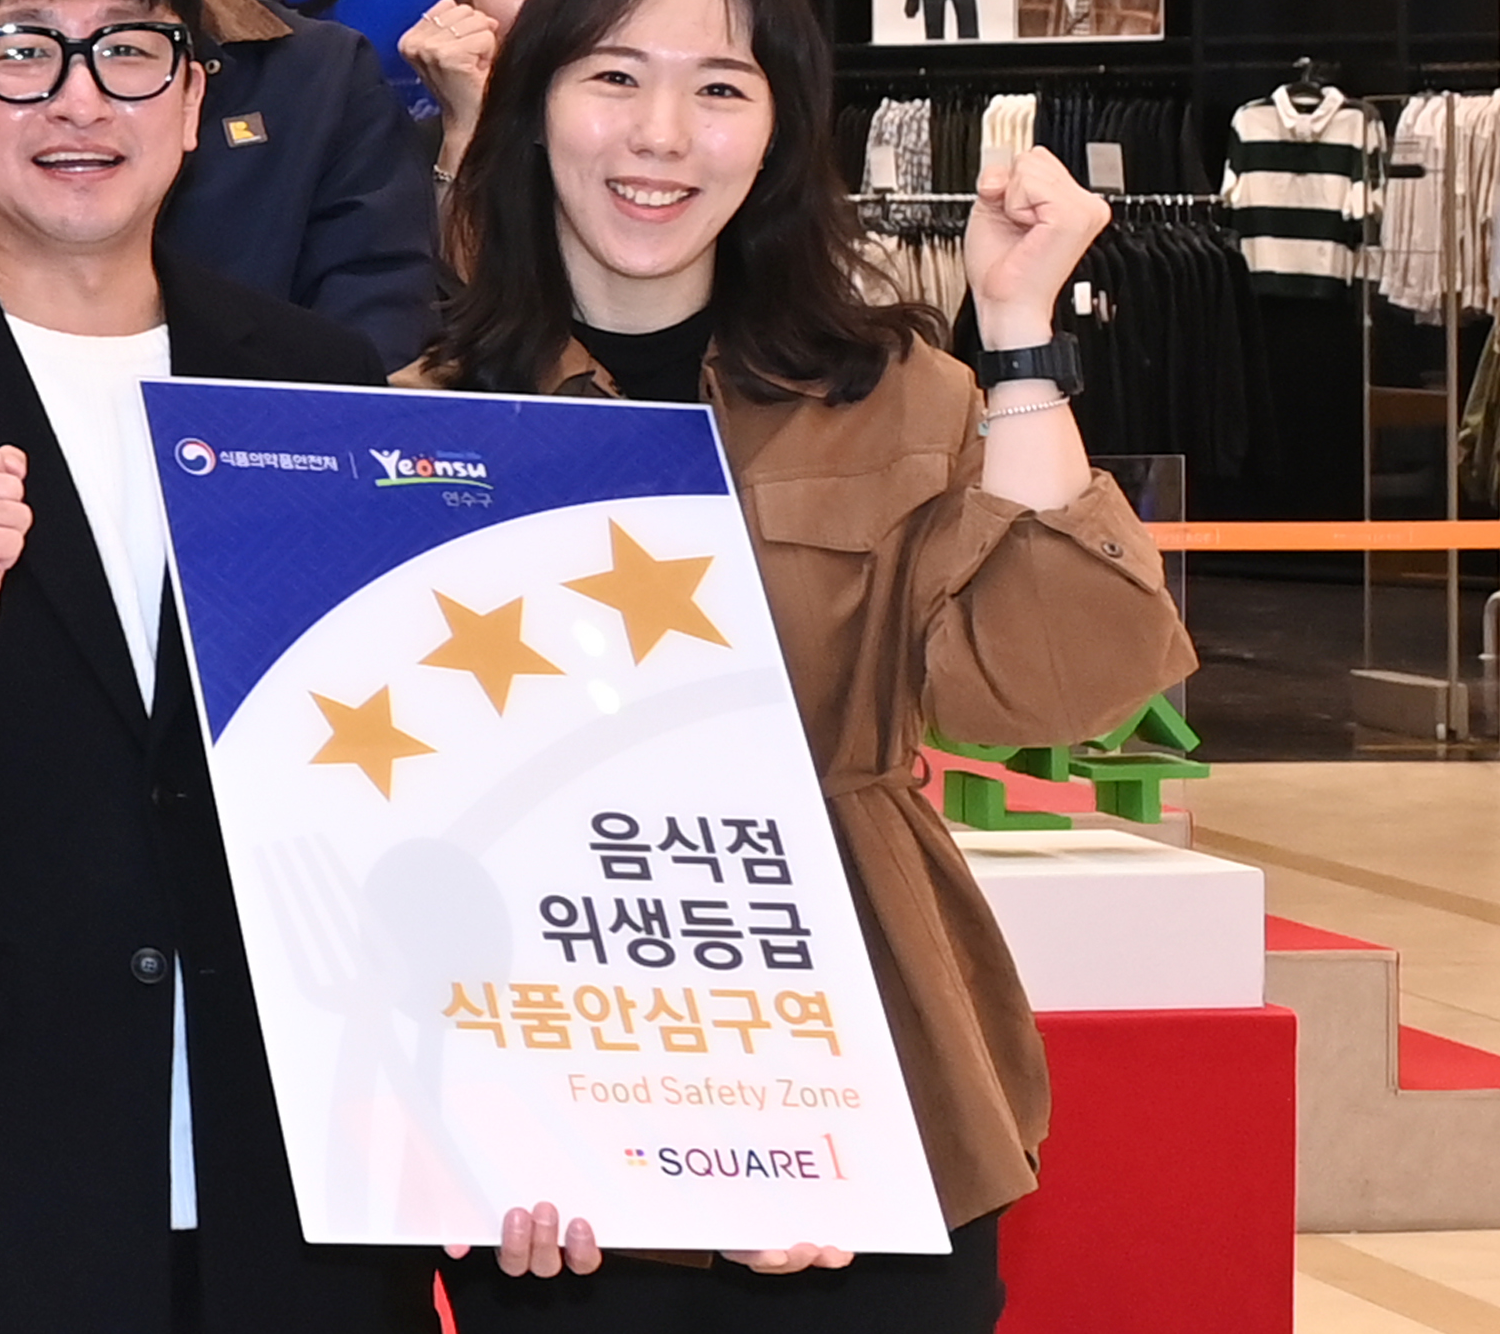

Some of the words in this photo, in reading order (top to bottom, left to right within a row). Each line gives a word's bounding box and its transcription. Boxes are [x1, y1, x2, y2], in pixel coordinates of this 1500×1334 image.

[368, 448, 488, 481] Yeonsu
[441, 490, 494, 509] 연수구
[588, 811, 793, 886] 음식점
[538, 894, 814, 970] 위생등급
[441, 981, 842, 1057] 식품안심구역
[568, 1073, 652, 1105] Food
[660, 1075, 767, 1111] Safety
[775, 1078, 862, 1109] Zone
